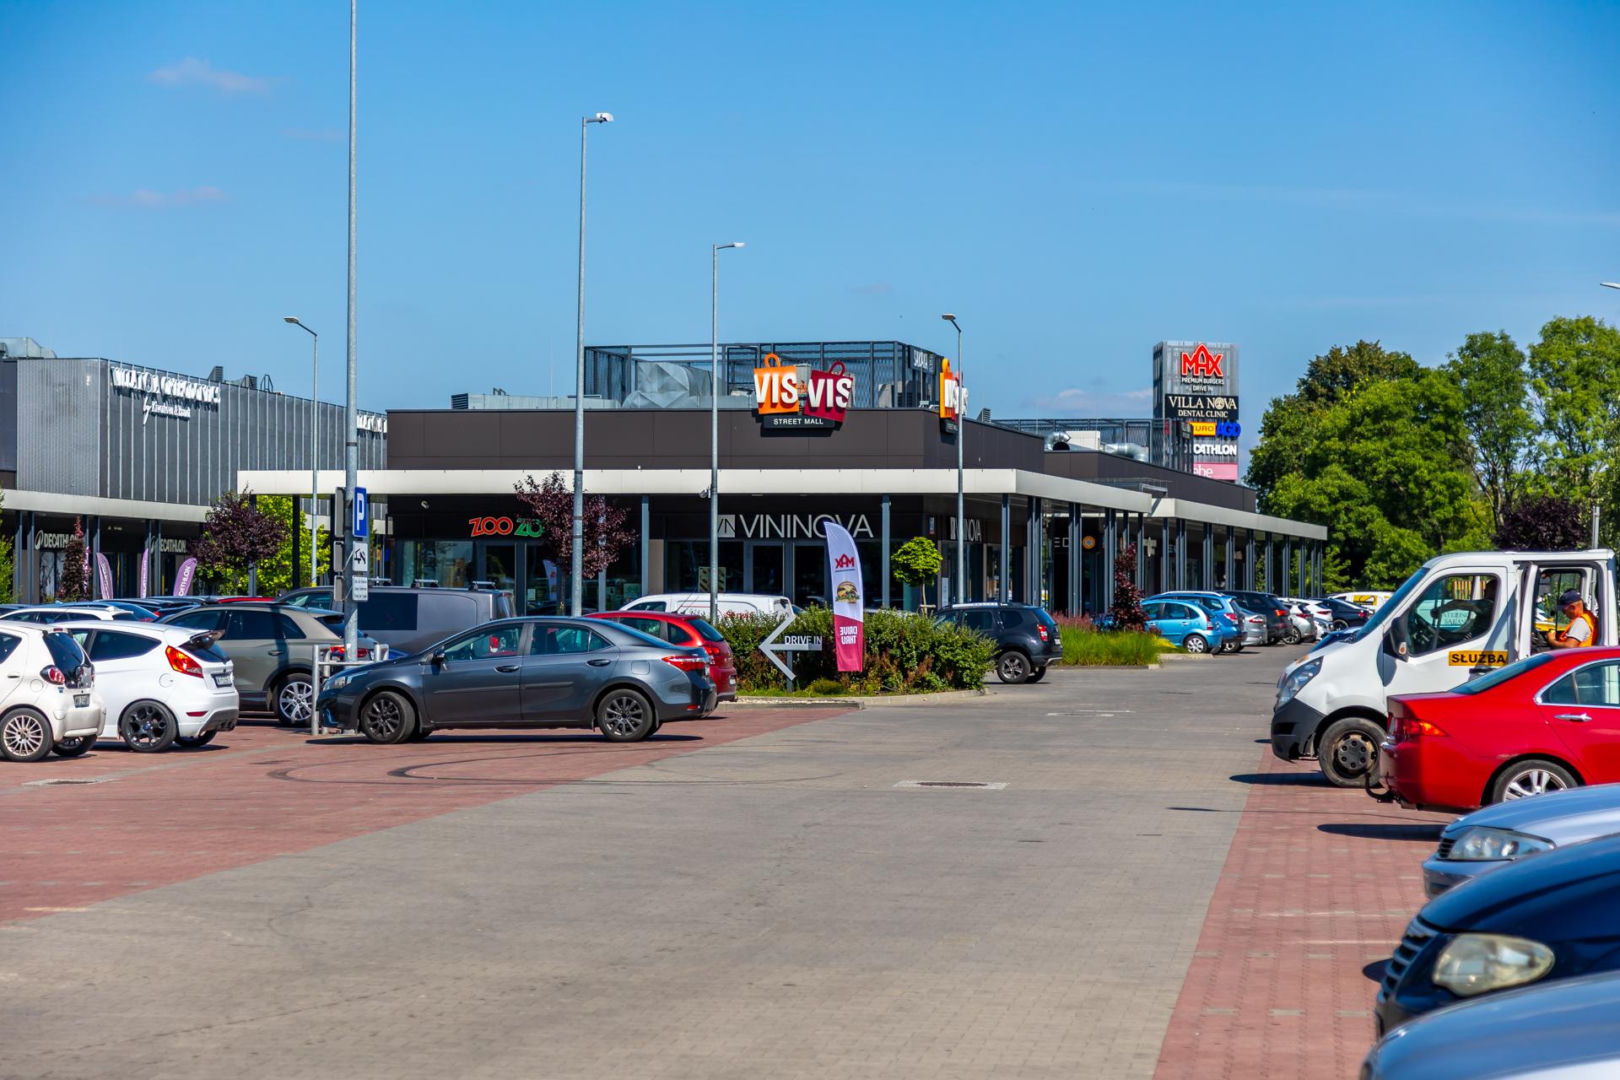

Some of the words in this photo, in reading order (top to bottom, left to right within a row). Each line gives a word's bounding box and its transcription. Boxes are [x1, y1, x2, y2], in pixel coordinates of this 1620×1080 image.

[1181, 343, 1224, 377] MAX
[753, 372, 799, 404] VIS
[807, 377, 853, 408] VIS
[1168, 396, 1205, 409] VILLA
[1206, 397, 1237, 410] NOVA
[773, 418, 802, 426] STREET
[804, 418, 824, 426] MALL
[1205, 410, 1229, 418] CLINIC
[1216, 420, 1241, 437] AGD
[356, 492, 365, 531] P
[468, 516, 514, 538] ZOO
[739, 514, 874, 538] VININOVA
[160, 538, 187, 553] ECATHLON
[784, 635, 812, 645] DRIVE
[813, 635, 822, 645] IN
